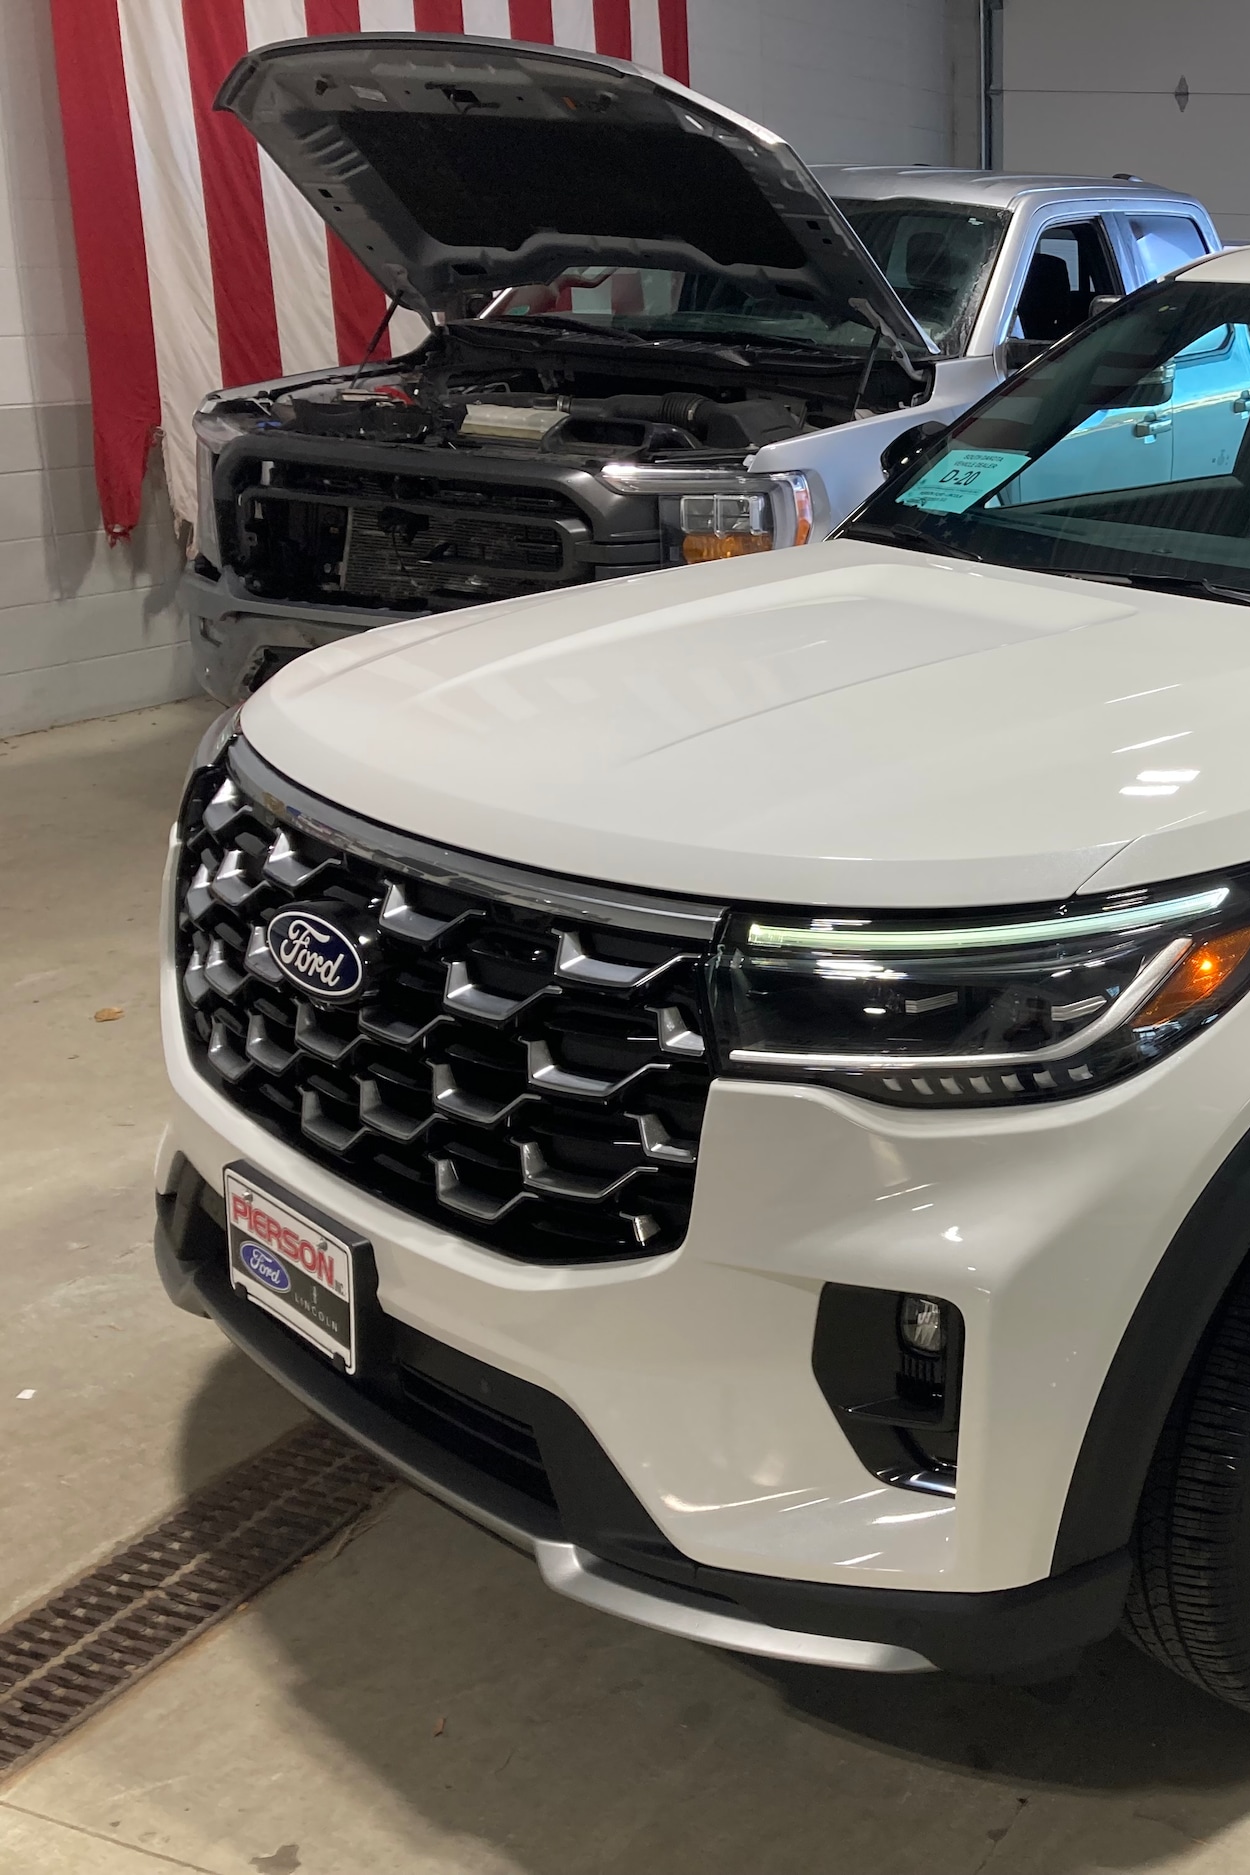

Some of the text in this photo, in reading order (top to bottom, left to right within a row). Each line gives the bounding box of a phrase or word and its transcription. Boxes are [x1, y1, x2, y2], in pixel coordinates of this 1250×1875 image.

[939, 469, 981, 486] D-20
[280, 919, 345, 987] Ford
[231, 1195, 335, 1288] PIERSON
[249, 1246, 282, 1286] Ford
[294, 1292, 338, 1333] LINCOLN
